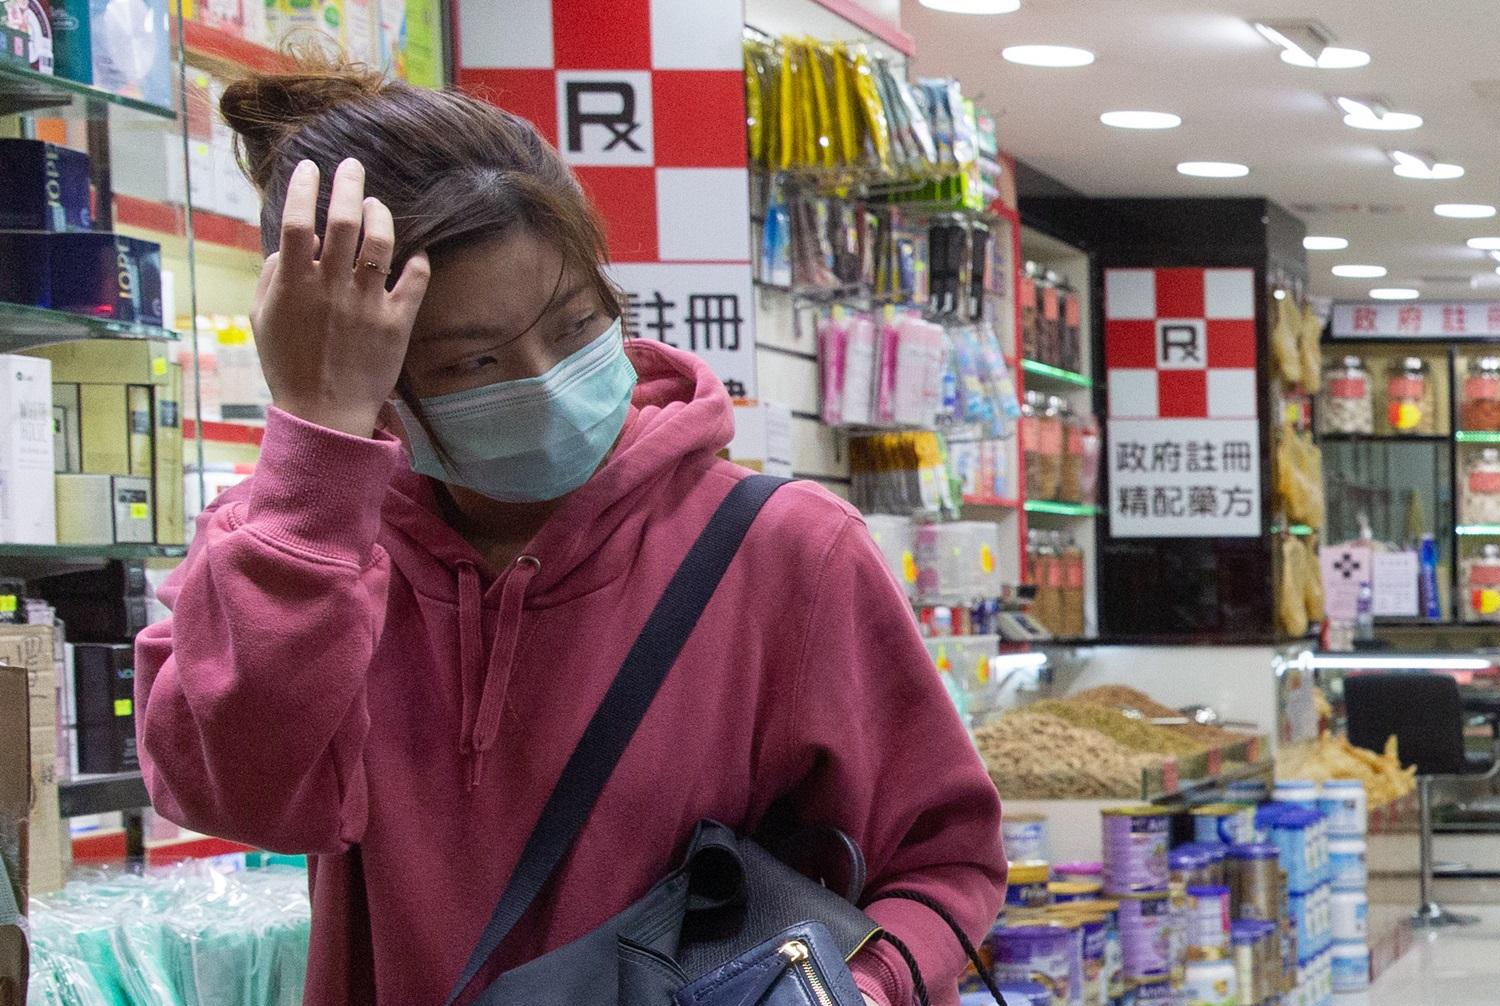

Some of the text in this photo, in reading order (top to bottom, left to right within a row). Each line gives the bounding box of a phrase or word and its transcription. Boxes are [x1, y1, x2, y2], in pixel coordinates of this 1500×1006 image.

[1116, 442, 1250, 472] 政府註冊
[1118, 486, 1252, 518] 精配藥方
